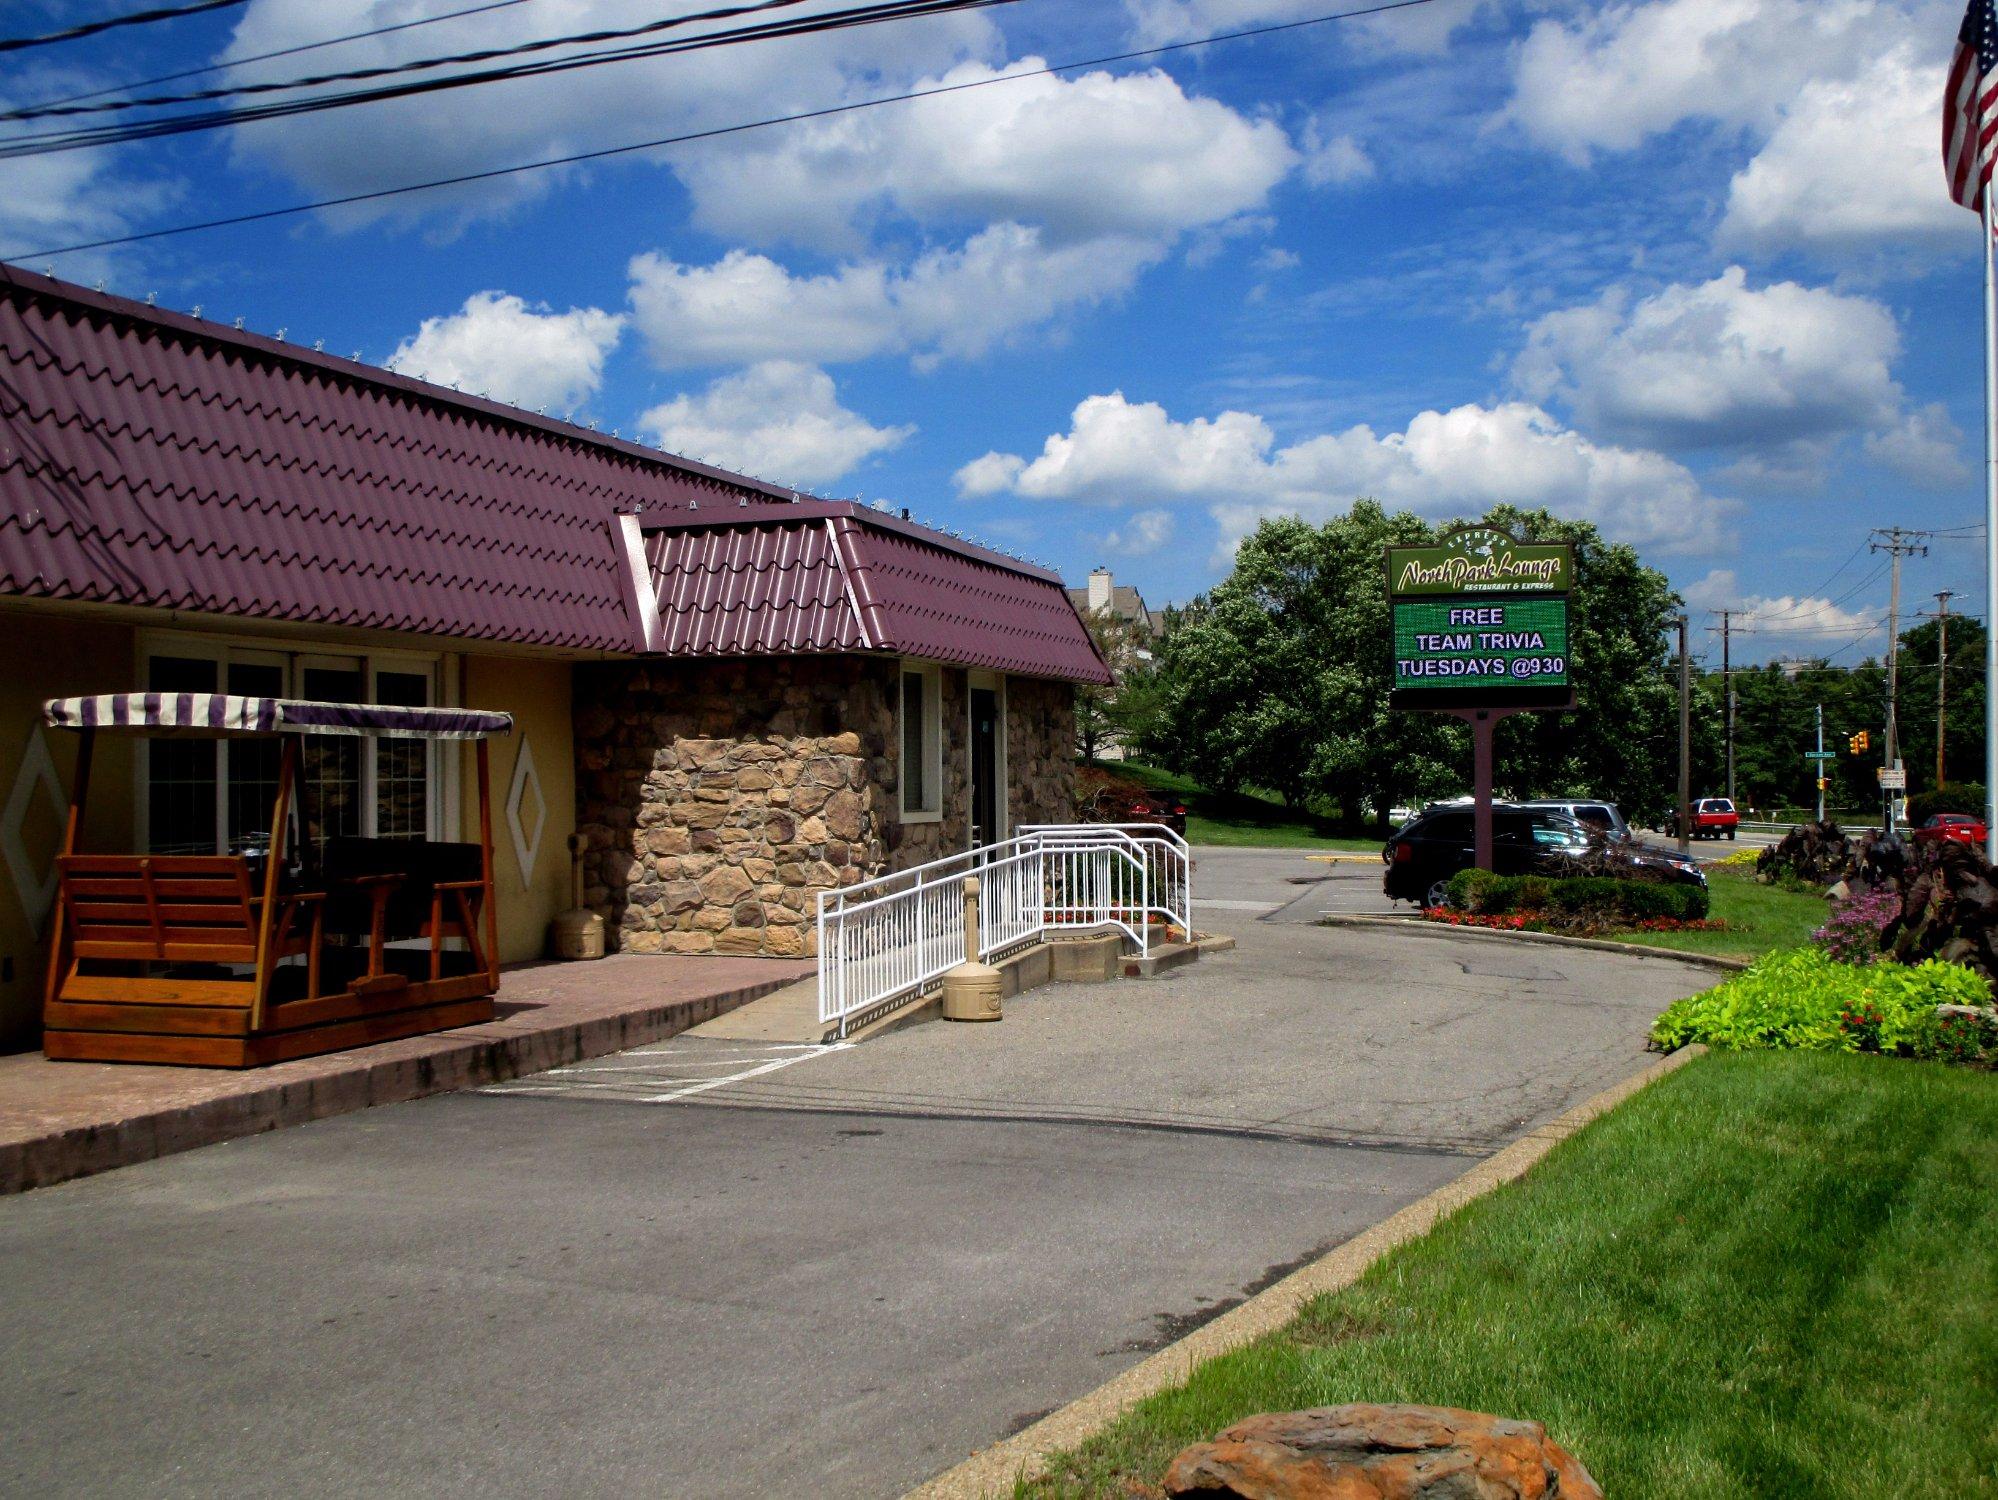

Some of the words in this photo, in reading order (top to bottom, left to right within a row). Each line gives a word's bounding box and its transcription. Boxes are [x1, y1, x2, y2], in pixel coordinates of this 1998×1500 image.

[1448, 531, 1507, 548] EXPRESS
[1398, 559, 1452, 591] North
[1450, 556, 1498, 588] Park
[1497, 551, 1561, 582] Lounge
[1464, 583, 1511, 591] RESTAURANT
[1521, 582, 1554, 590] EXPRESS
[1450, 608, 1503, 625] FREE
[1416, 634, 1472, 650] TEAM
[1479, 633, 1544, 649] TRIVIA
[1398, 658, 1505, 676] TUESDAYS
[1511, 657, 1564, 677] @930
